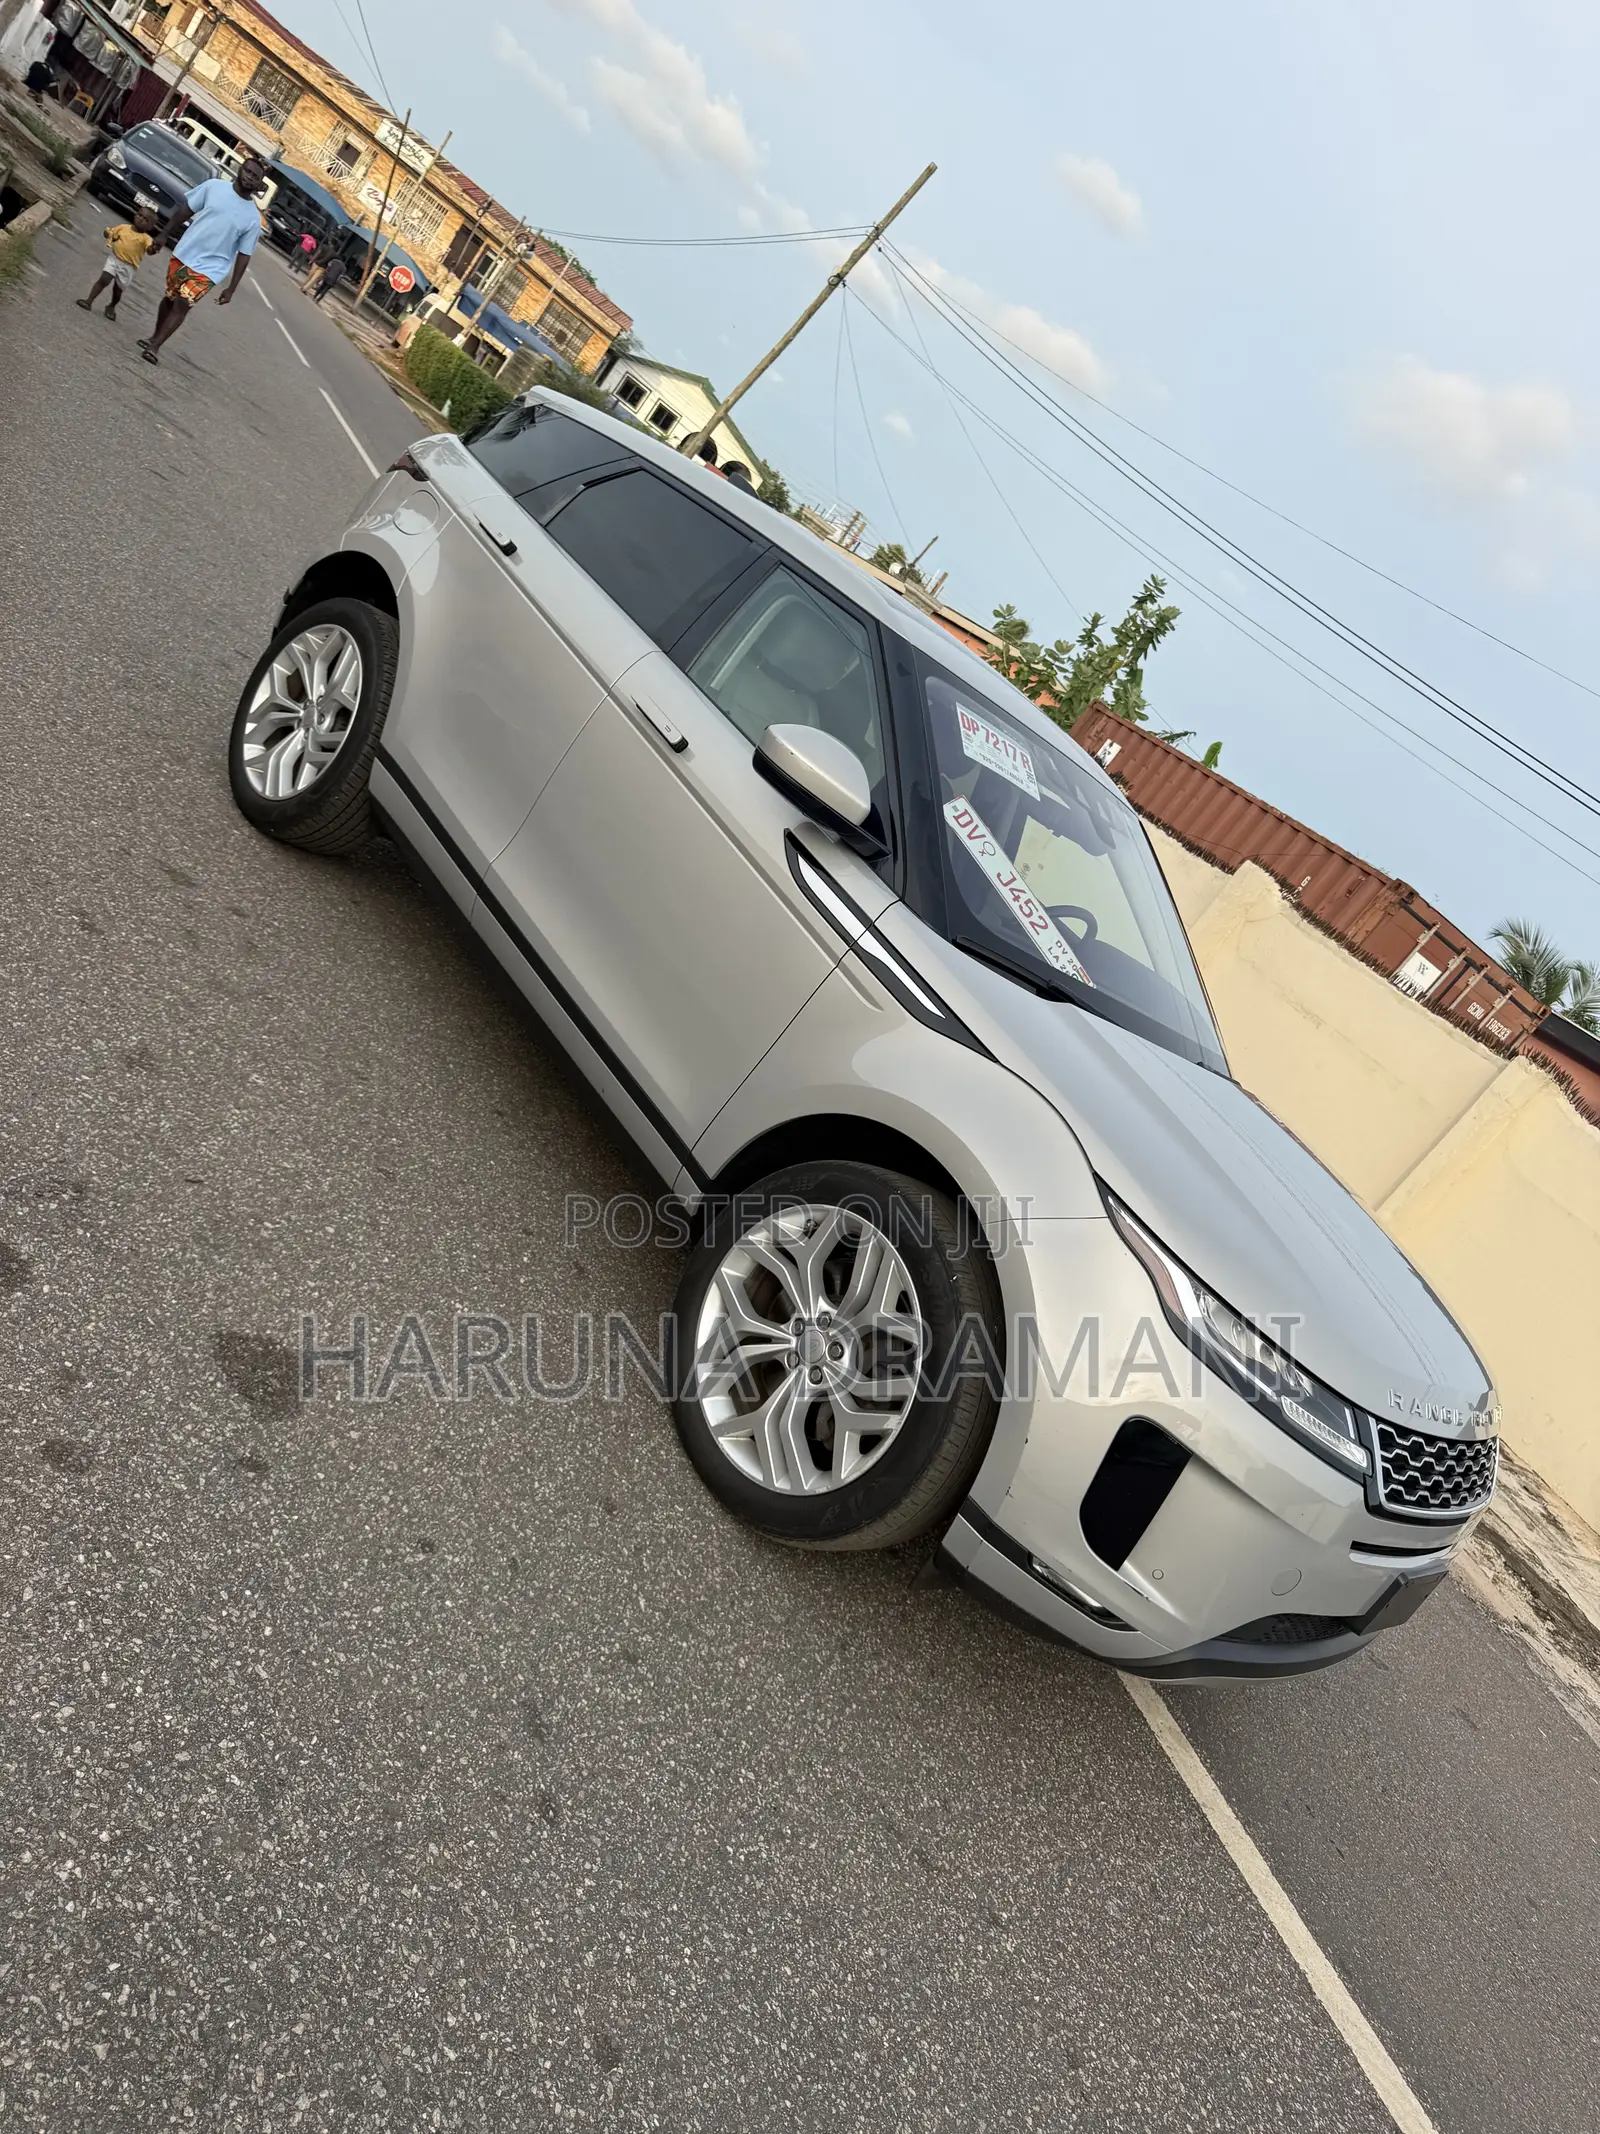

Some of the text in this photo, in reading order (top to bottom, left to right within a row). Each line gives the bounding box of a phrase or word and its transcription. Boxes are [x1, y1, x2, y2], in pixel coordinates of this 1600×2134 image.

[393, 271, 411, 285] STOP
[953, 808, 1049, 936] DV J452
[1387, 1388, 1464, 1426] RANGE
